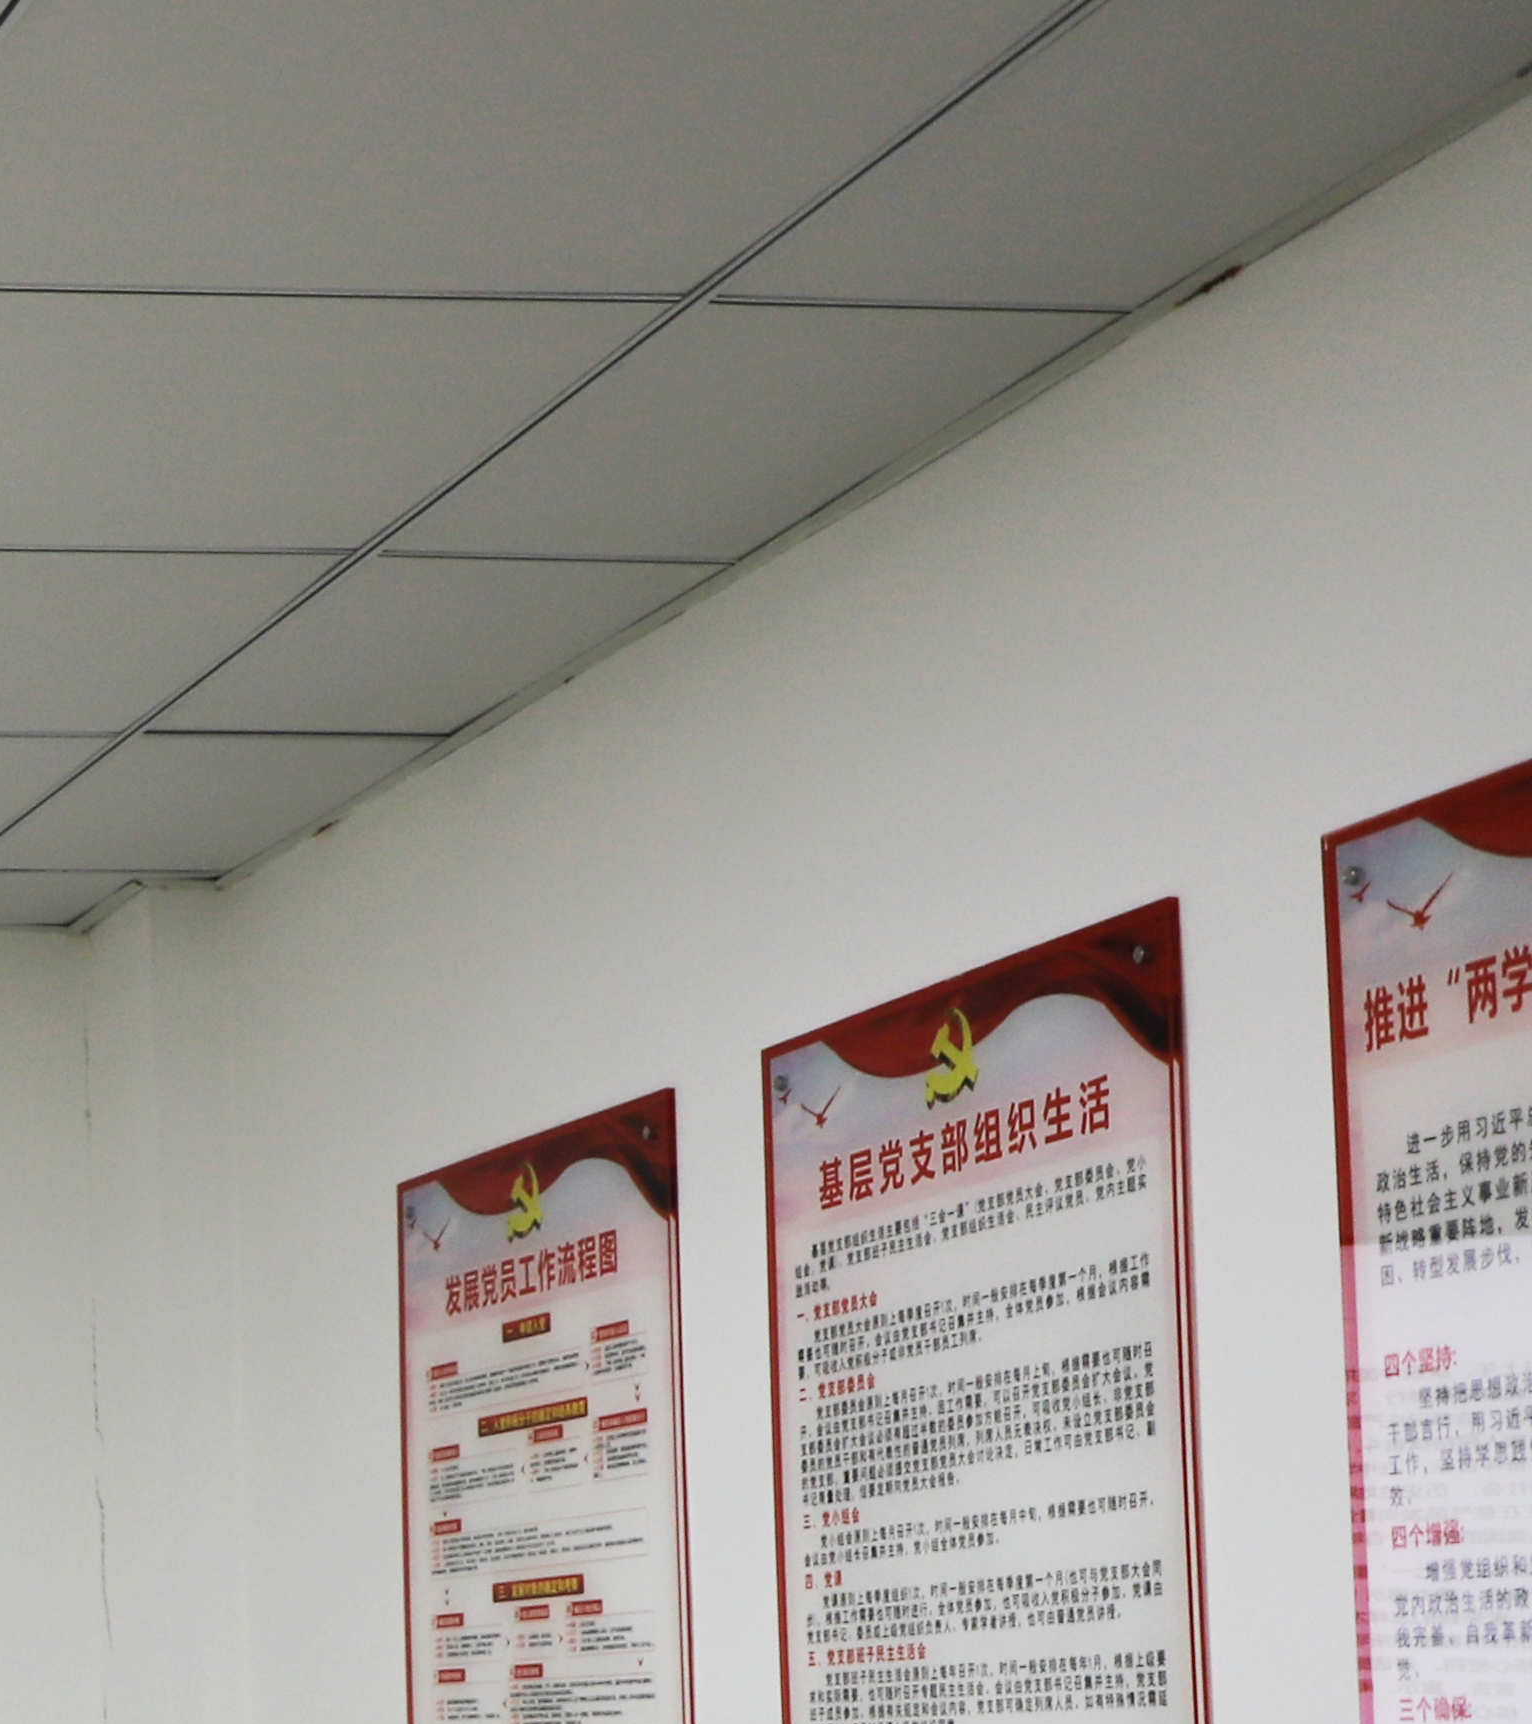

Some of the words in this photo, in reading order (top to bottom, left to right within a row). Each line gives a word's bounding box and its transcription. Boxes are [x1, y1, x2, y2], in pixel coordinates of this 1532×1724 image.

[819, 1074, 1110, 1210] 基层党支部组织生活
[1376, 1169, 1532, 1227] 特色社会主义事业新
[445, 1229, 618, 1316] 发展党员工作流程图
[1425, 1553, 1532, 1582] 增强党组织和
